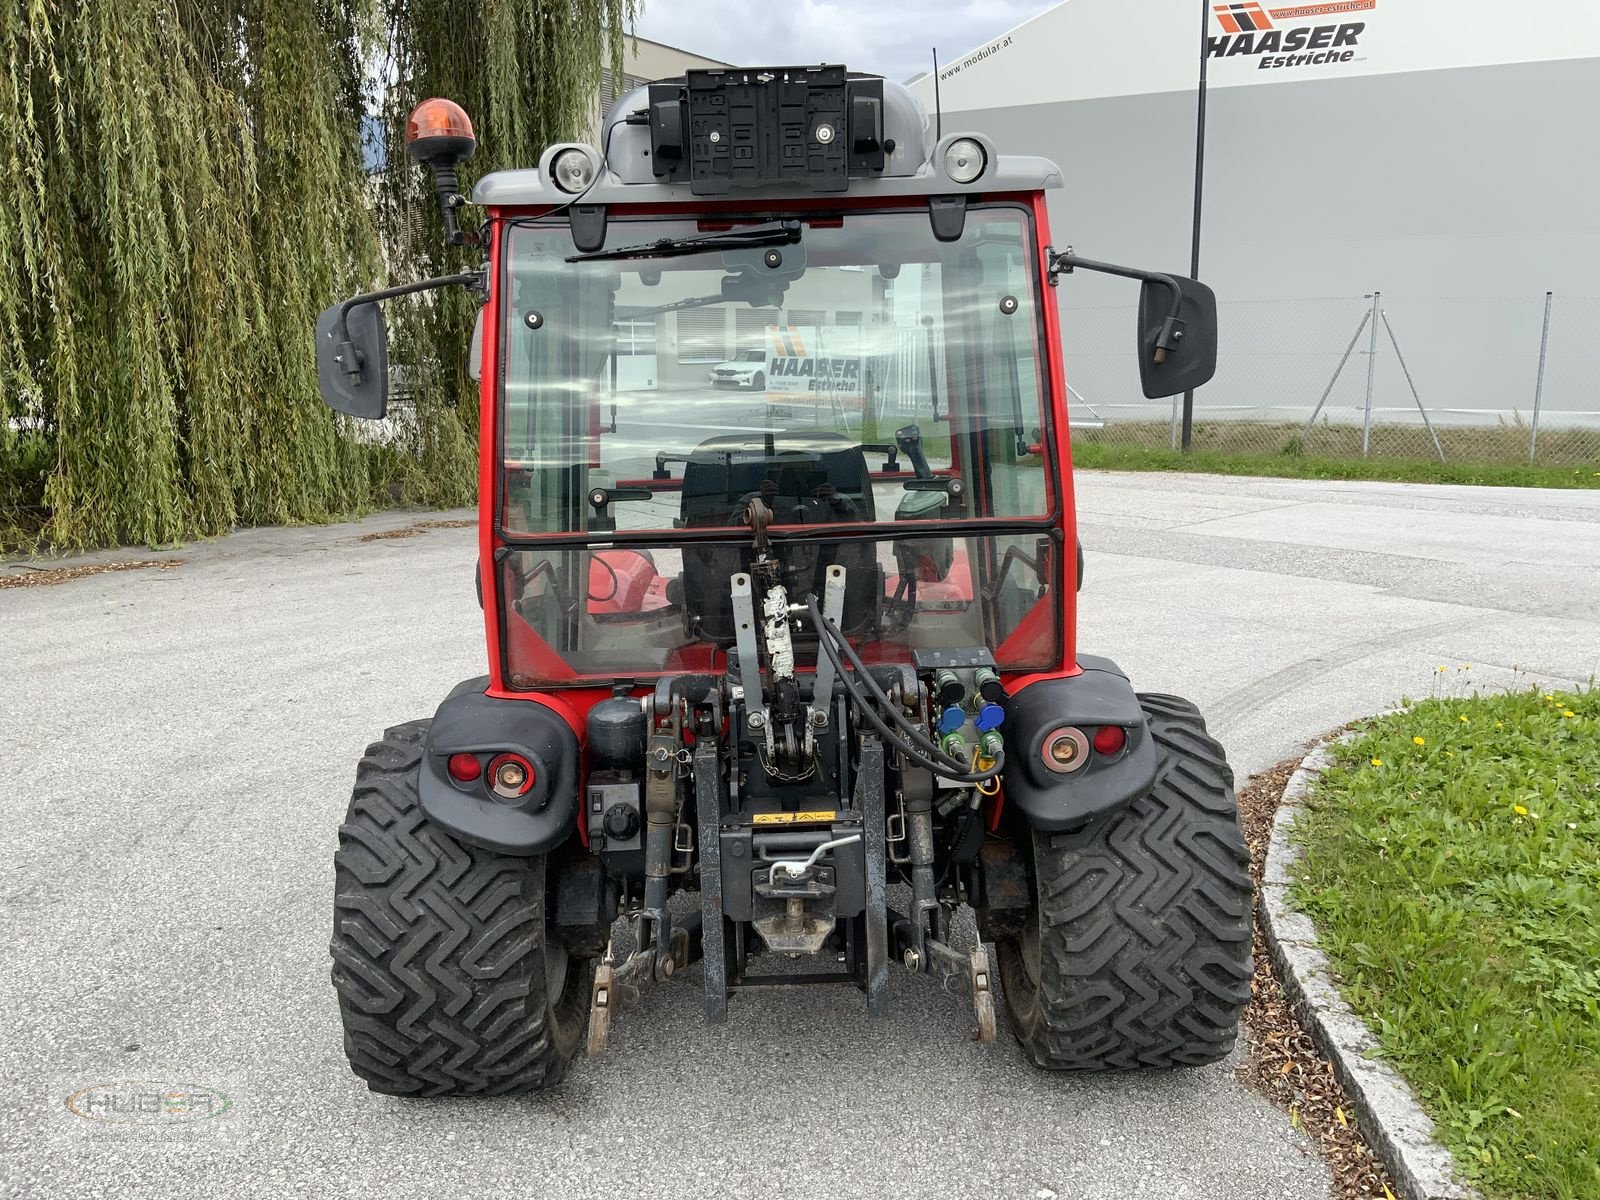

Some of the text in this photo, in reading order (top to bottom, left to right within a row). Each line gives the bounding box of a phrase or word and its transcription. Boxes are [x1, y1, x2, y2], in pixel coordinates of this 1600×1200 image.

[1273, 1, 1372, 18] www.haaser-estriche.at
[1207, 22, 1365, 58] HAASER
[940, 36, 1012, 80] www.modular.at
[1258, 50, 1354, 69] Estriche
[770, 358, 860, 378] HAASER
